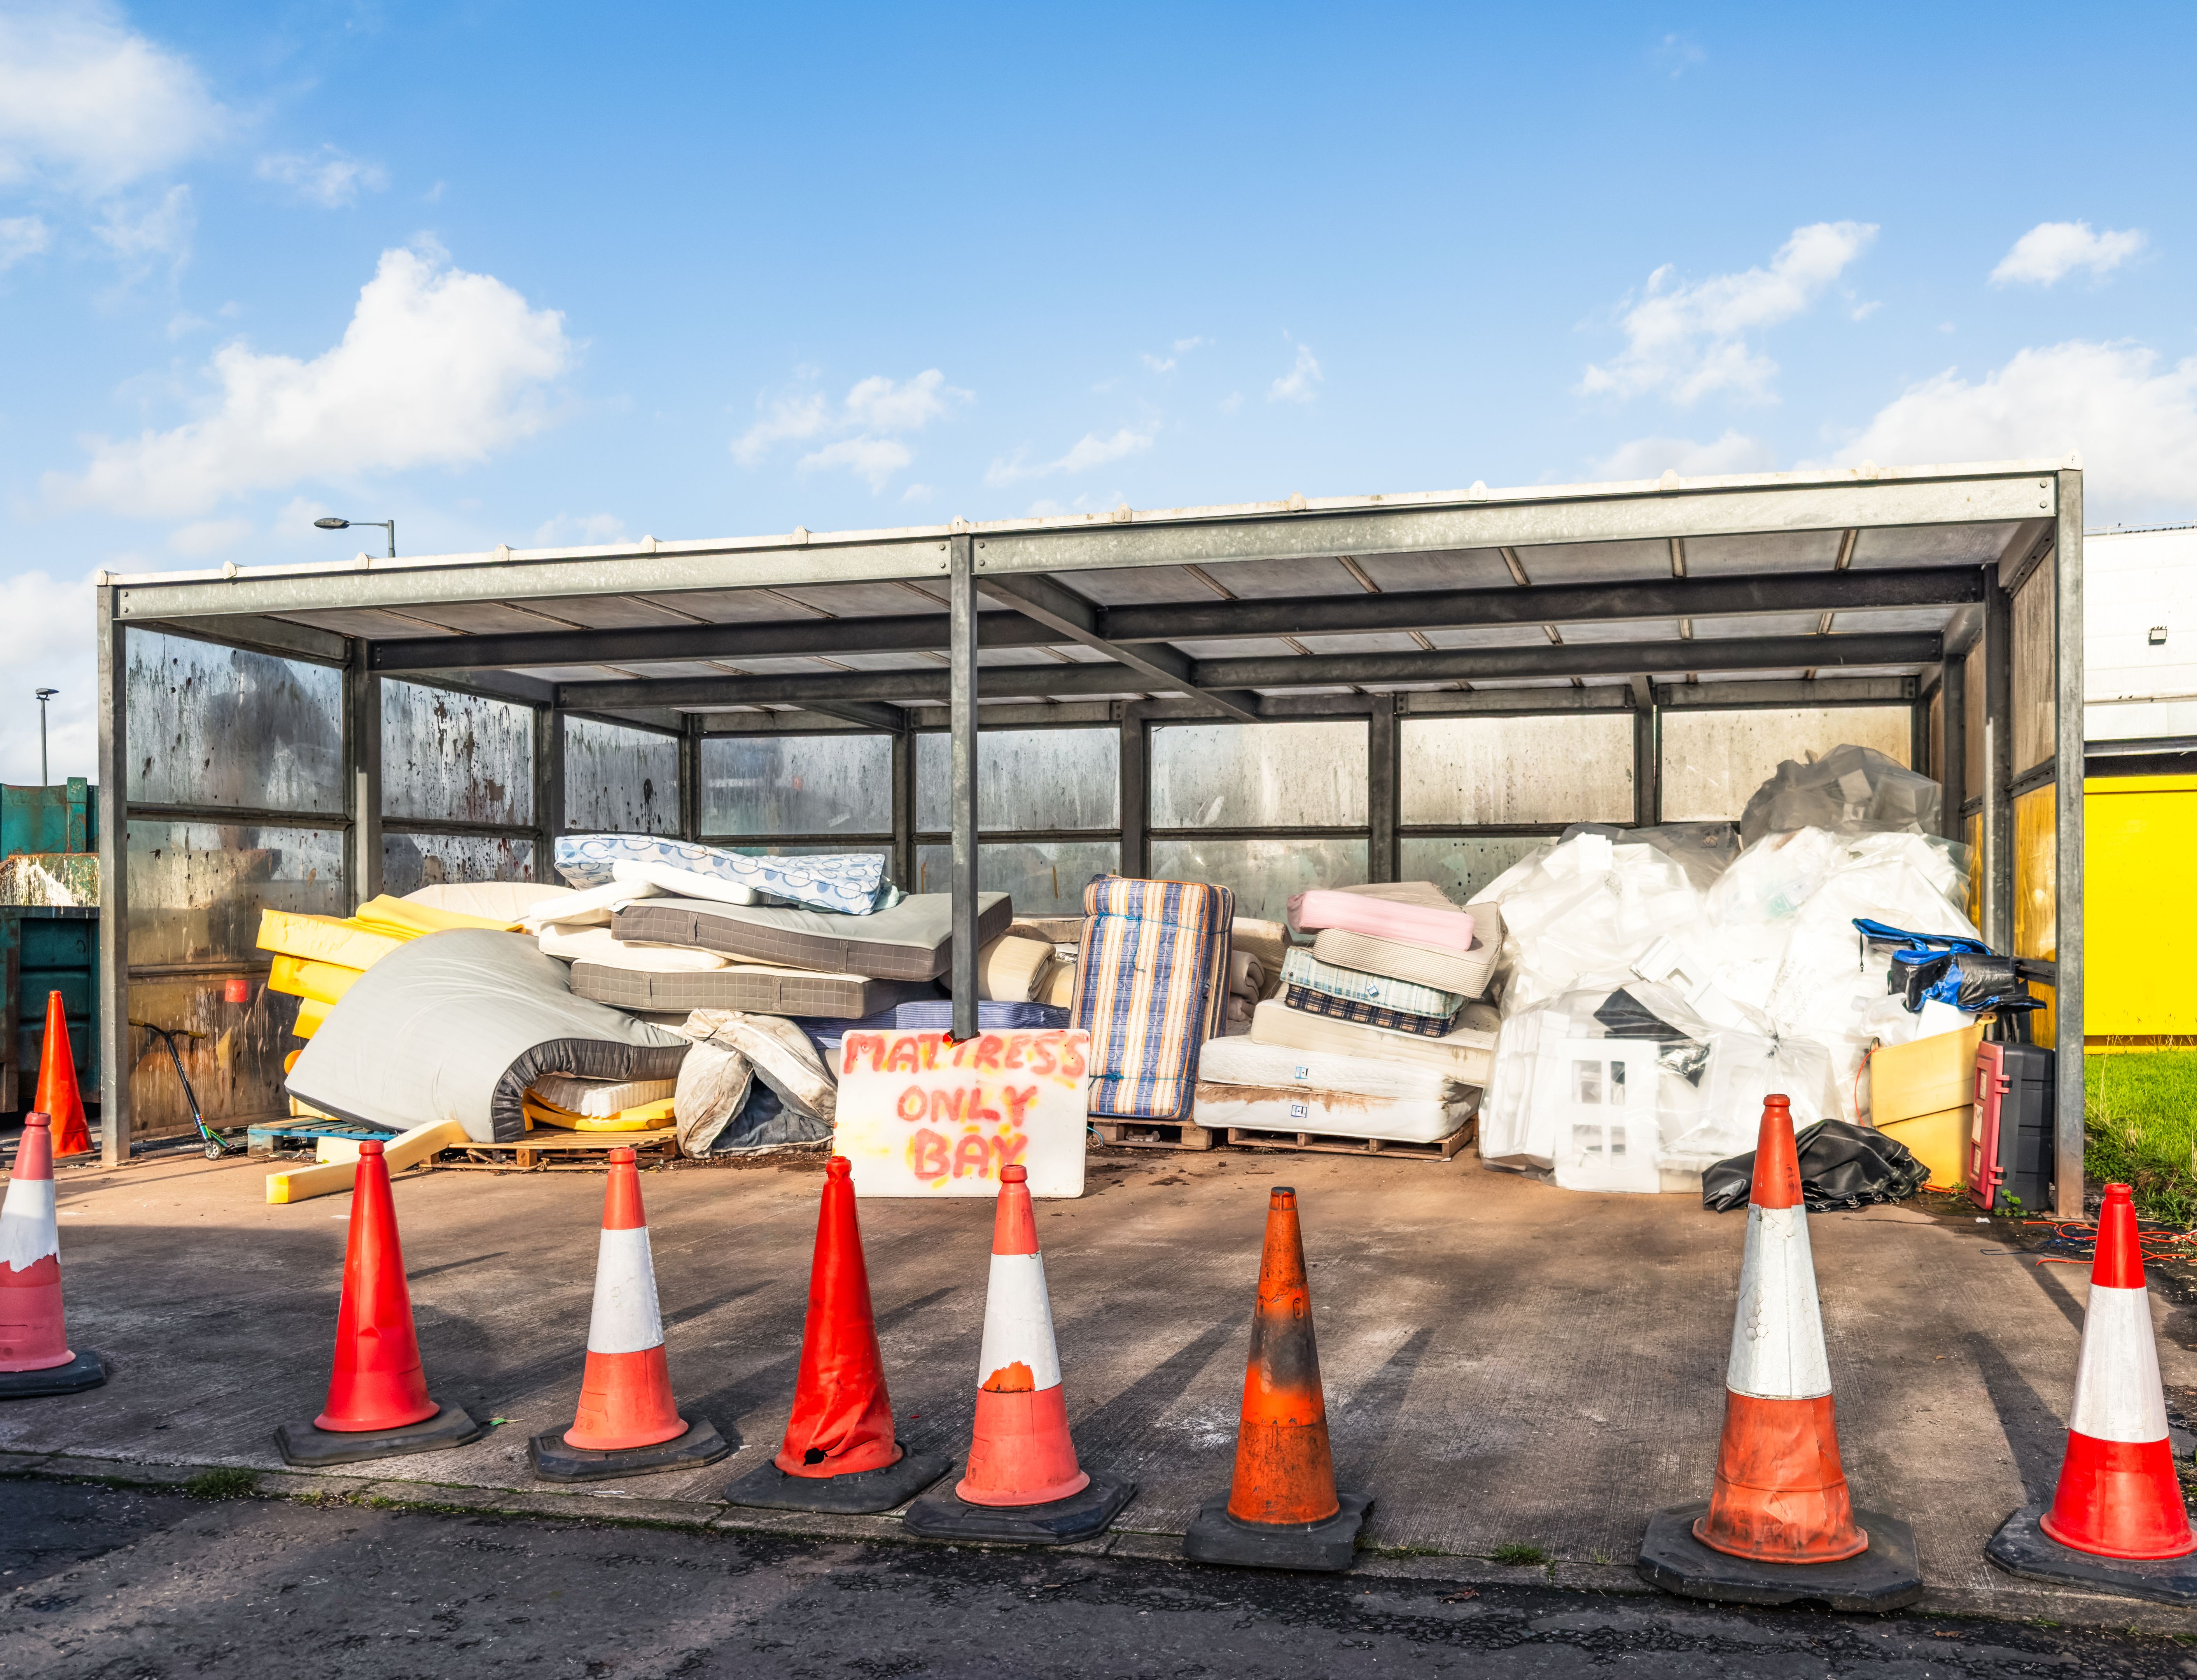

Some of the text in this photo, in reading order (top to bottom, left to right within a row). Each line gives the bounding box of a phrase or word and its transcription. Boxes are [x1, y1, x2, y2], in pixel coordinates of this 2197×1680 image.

[1775, 969, 1816, 1022] Polystyrne
[1784, 982, 1823, 1029] Recycling
[897, 1085, 1038, 1127] ONLY
[914, 1128, 1029, 1180] BAY
